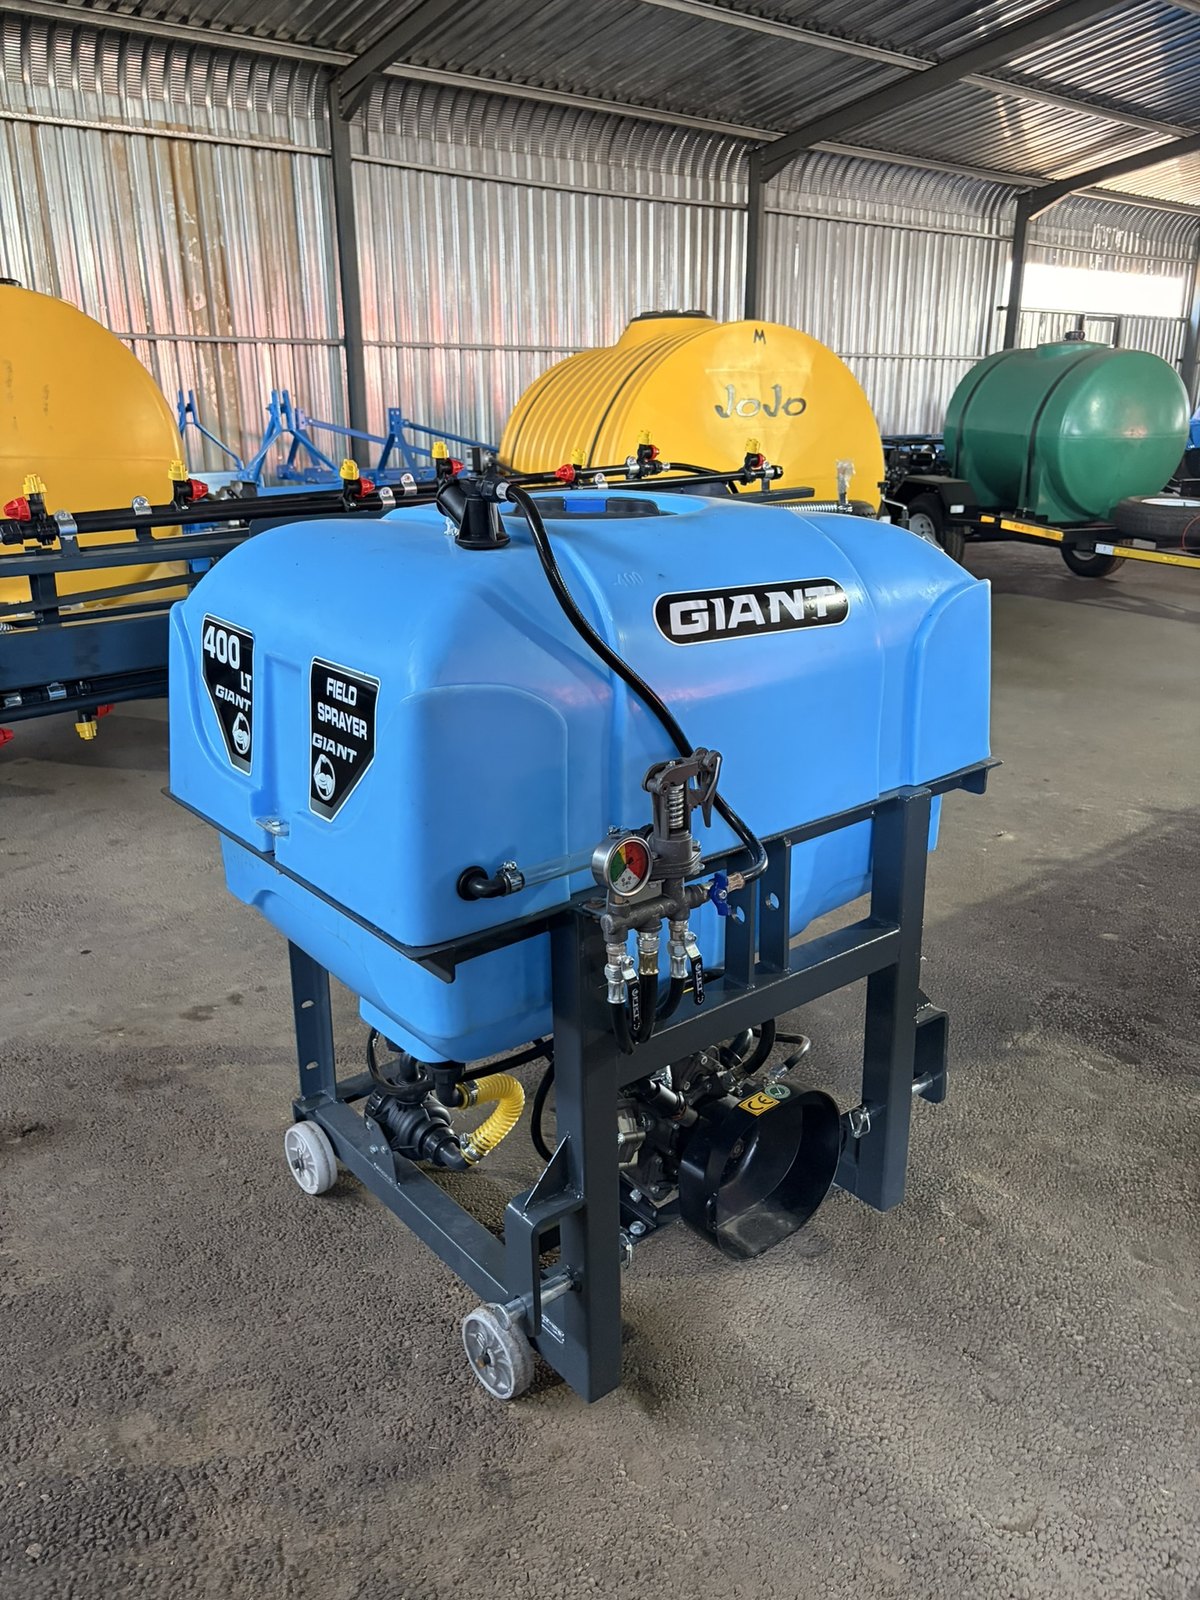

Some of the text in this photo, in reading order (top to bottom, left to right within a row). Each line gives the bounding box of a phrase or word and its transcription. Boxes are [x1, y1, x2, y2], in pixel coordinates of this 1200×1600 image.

[753, 328, 767, 345] M
[714, 384, 807, 418] JoJo
[669, 585, 836, 636] GIANT
[203, 625, 240, 670] 400
[240, 671, 252, 693] LT
[326, 677, 358, 707] FIELD
[215, 684, 252, 712] GIANT
[317, 701, 368, 741] SPRAYER
[312, 732, 358, 763] GIANT
[747, 1095, 774, 1111] CE
